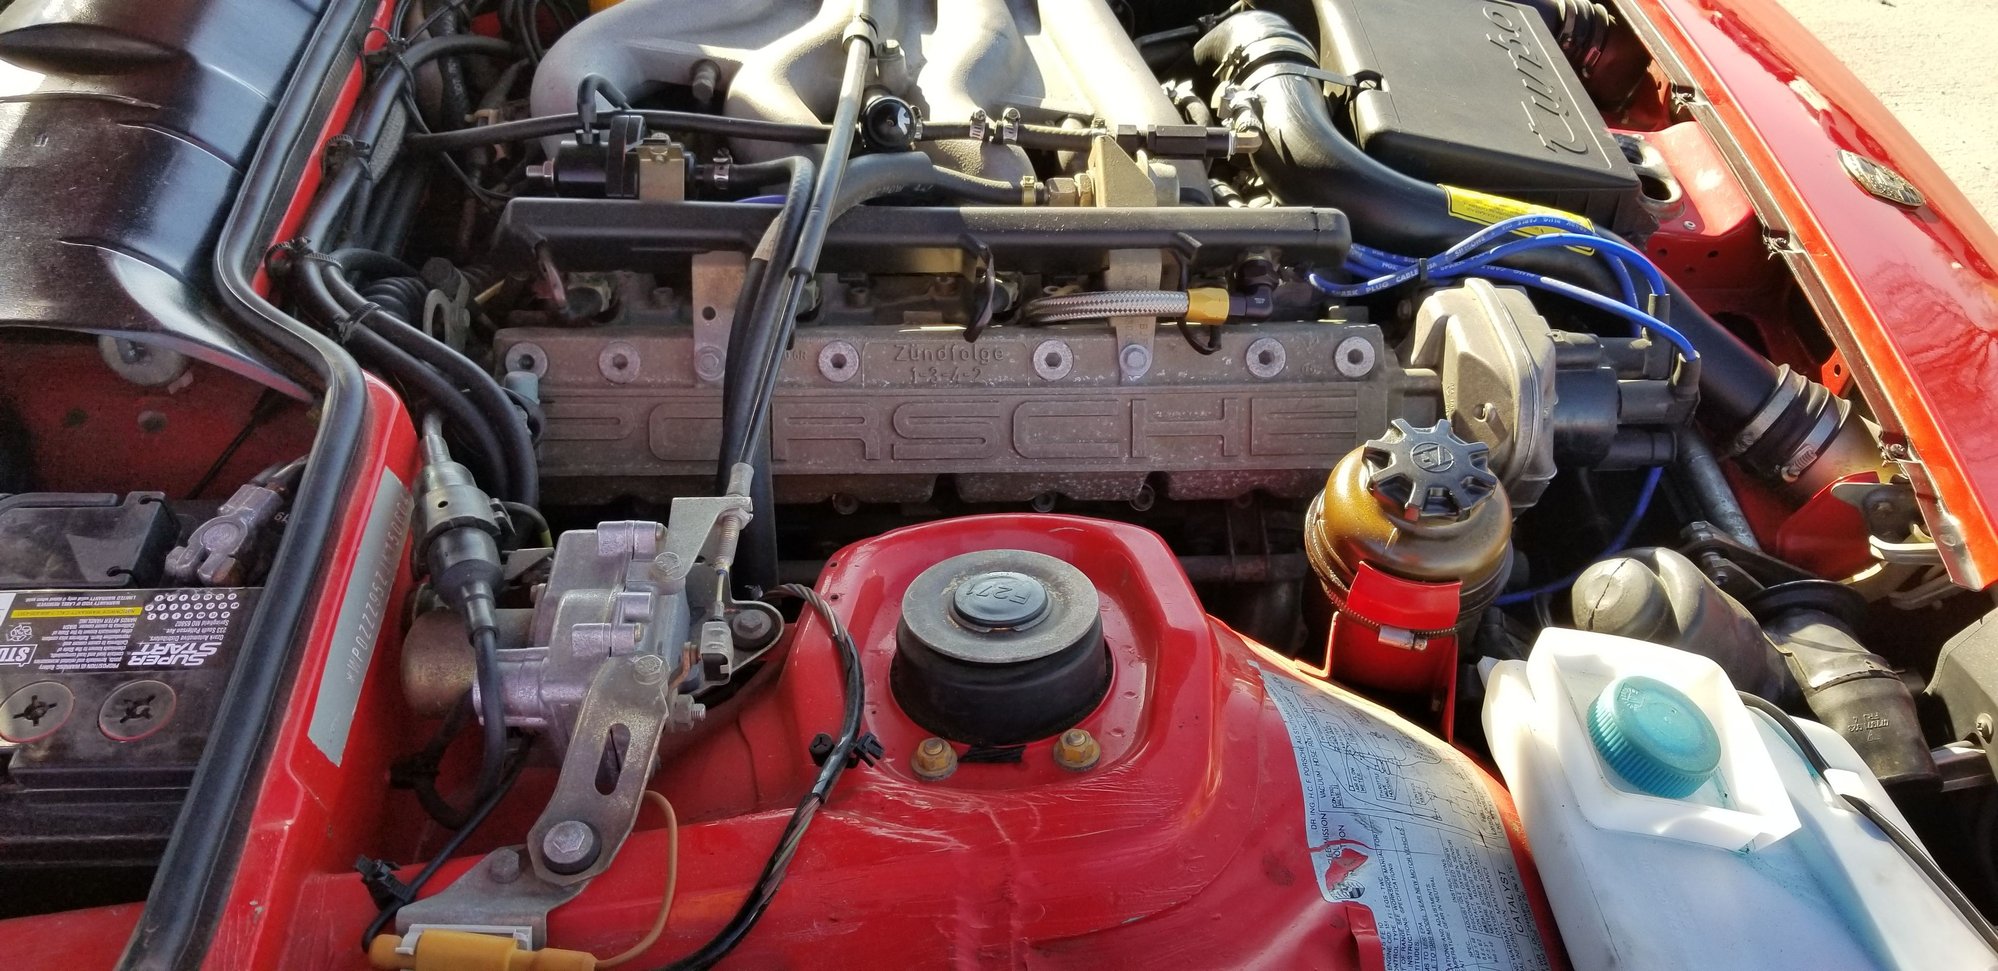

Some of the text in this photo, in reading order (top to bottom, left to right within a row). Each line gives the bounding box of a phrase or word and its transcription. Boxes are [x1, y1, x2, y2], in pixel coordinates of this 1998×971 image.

[1366, 281, 1389, 293] PLUG
[1396, 268, 1418, 282] CABLE
[893, 343, 1004, 366] Zündfolge
[910, 366, 982, 385] 1-3-4-2
[200, 619, 230, 627] Springfield
[131, 642, 222, 656] START
[127, 654, 207, 666] SUPER
[1497, 867, 1524, 933] CATALYST
[1499, 921, 1515, 960] WARRANTY
